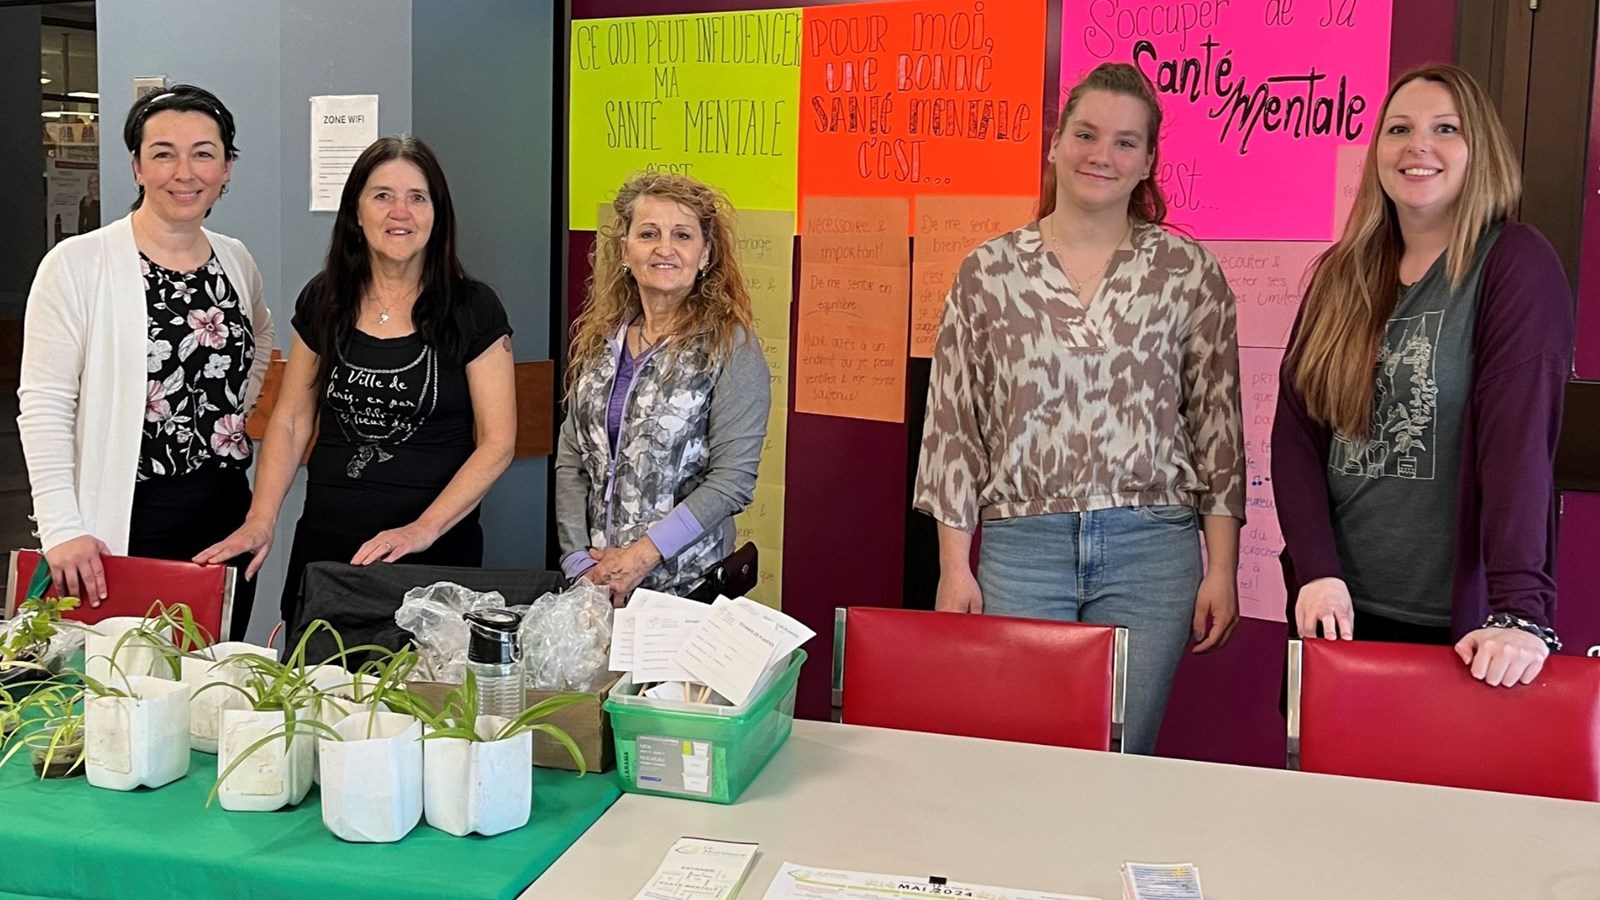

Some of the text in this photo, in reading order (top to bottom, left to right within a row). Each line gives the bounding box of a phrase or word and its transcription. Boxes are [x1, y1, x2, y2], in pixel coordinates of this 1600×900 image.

[577, 25, 601, 70] CE
[607, 21, 637, 66] QUI
[646, 18, 688, 64] PEUT
[809, 15, 888, 57] POUR
[653, 66, 680, 99] MA
[323, 115, 365, 124] ZONE WIFI
[683, 99, 786, 157] MENTALE
[810, 274, 824, 291] De
[347, 370, 384, 388] Ville
[389, 375, 408, 392] de
[367, 396, 384, 404] en
[897, 883, 927, 892] MAI
